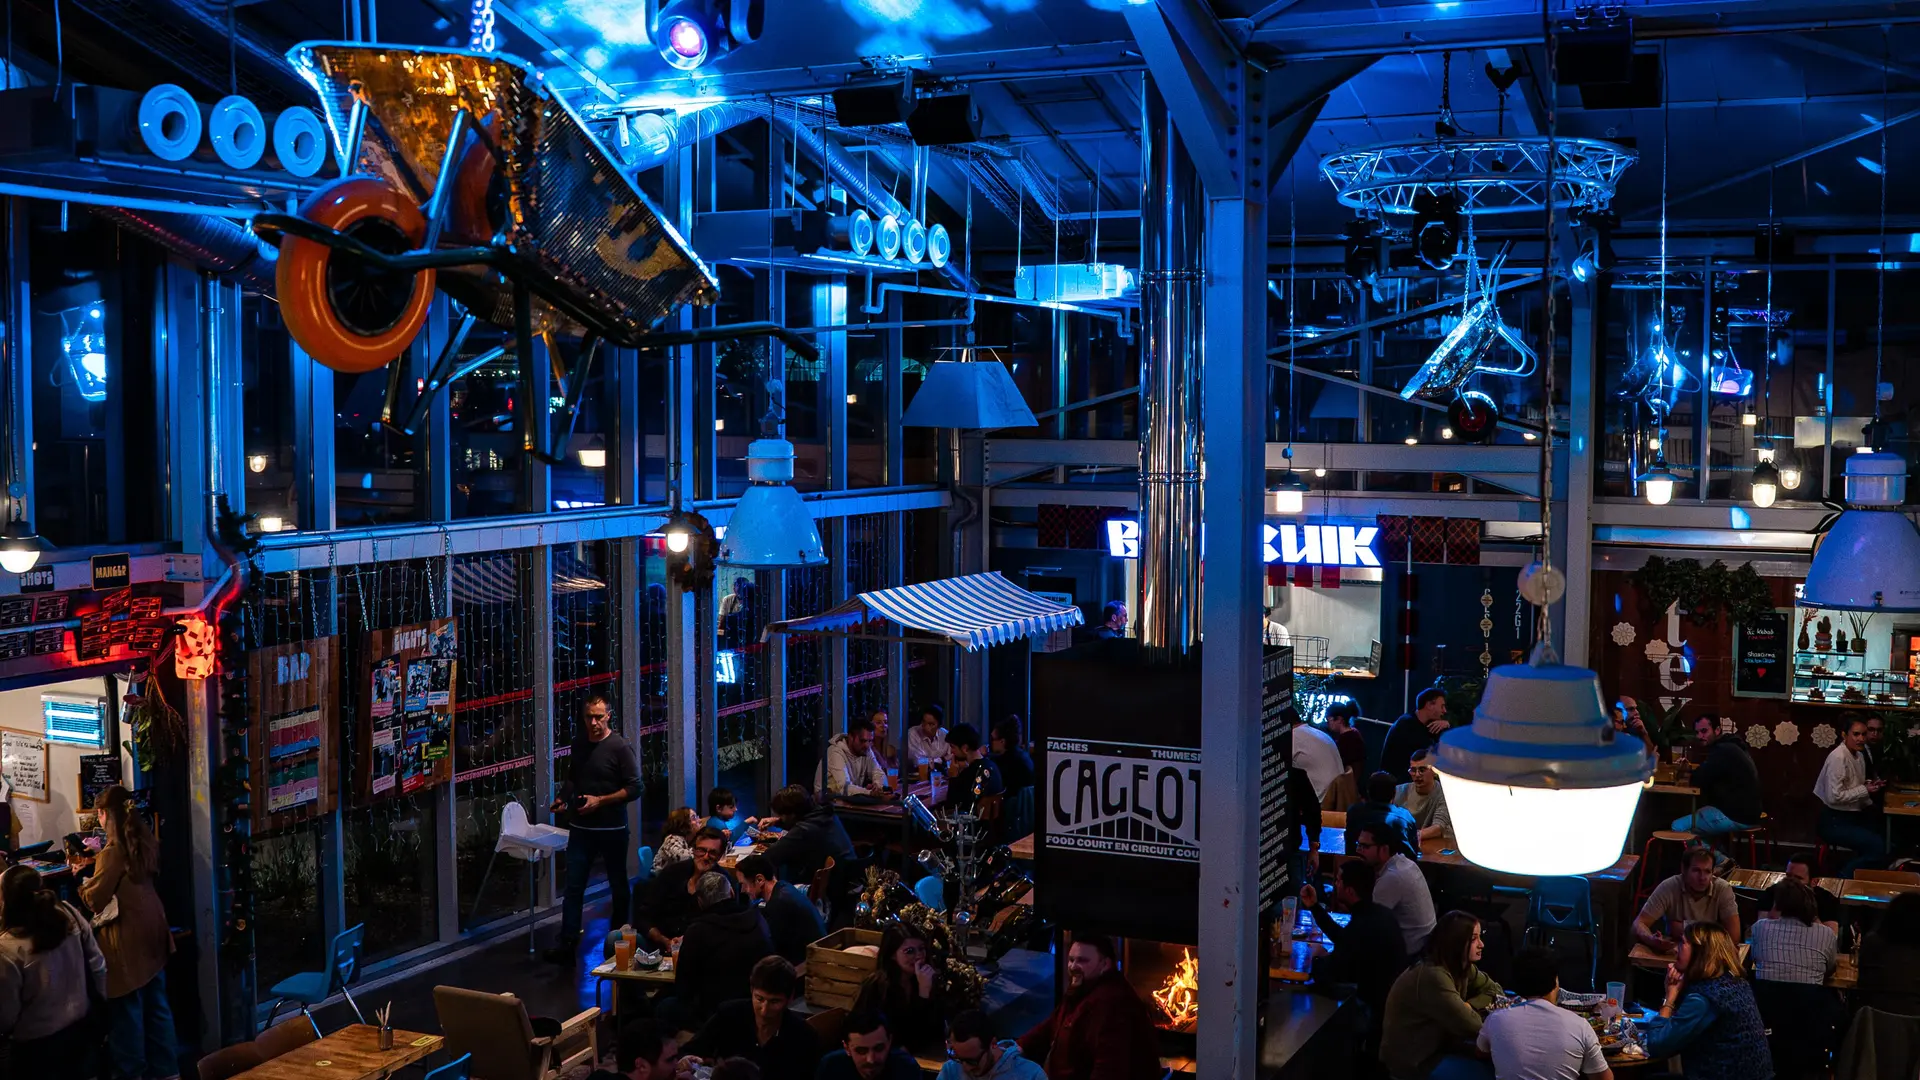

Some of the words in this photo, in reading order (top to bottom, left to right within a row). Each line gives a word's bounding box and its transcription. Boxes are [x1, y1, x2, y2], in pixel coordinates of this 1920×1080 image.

[20, 570, 54, 587] SHOTS
[277, 651, 312, 685] BAR
[1046, 741, 1089, 752] FACHES
[1053, 758, 1201, 842] CAGEOT
[1045, 835, 1076, 847] FOOD
[1076, 838, 1114, 850] COURT
[1114, 842, 1131, 852] EN
[1131, 844, 1175, 857] CIRCUIT
[1175, 848, 1200, 859] COU
